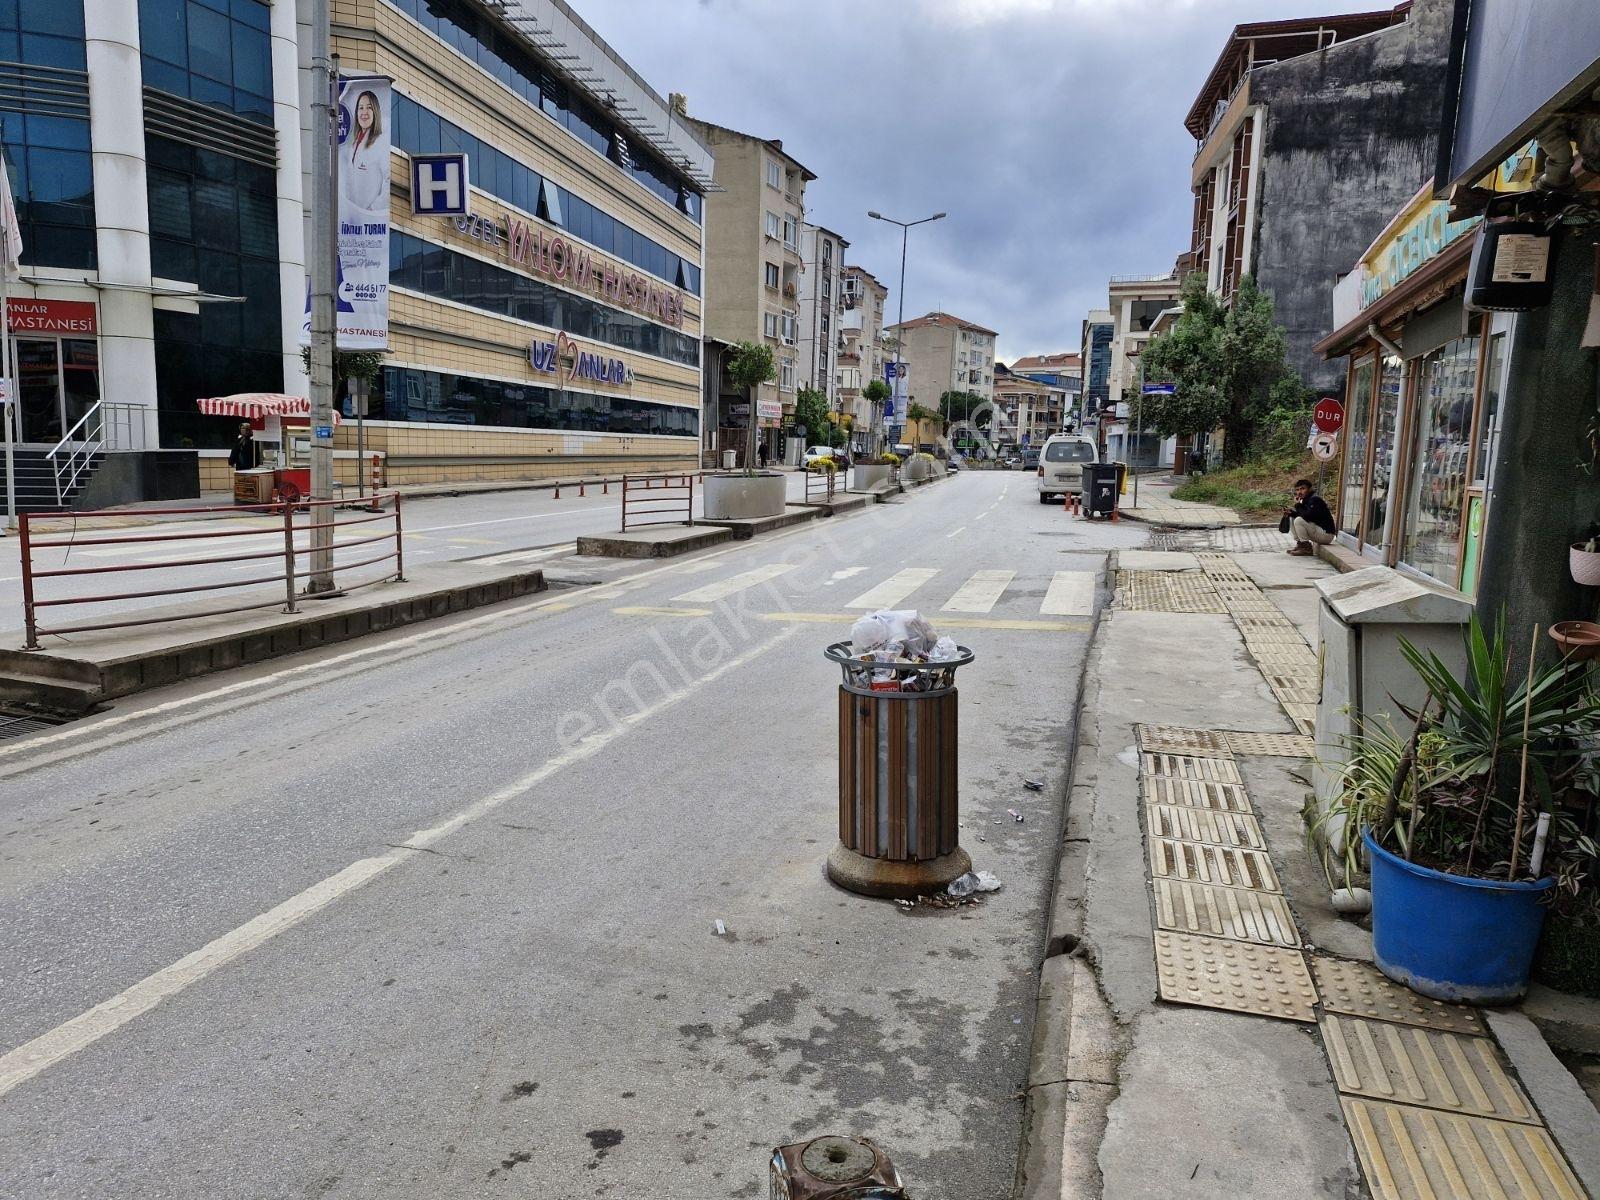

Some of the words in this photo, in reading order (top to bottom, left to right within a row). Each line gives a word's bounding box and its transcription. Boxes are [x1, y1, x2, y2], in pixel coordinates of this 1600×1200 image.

[419, 163, 460, 209] H
[363, 223, 387, 236] TURAN
[504, 213, 595, 291] YALOVA
[5, 304, 48, 314] ANLAR
[7, 315, 92, 331] HASTANESİ
[1317, 410, 1341, 421] DUR
